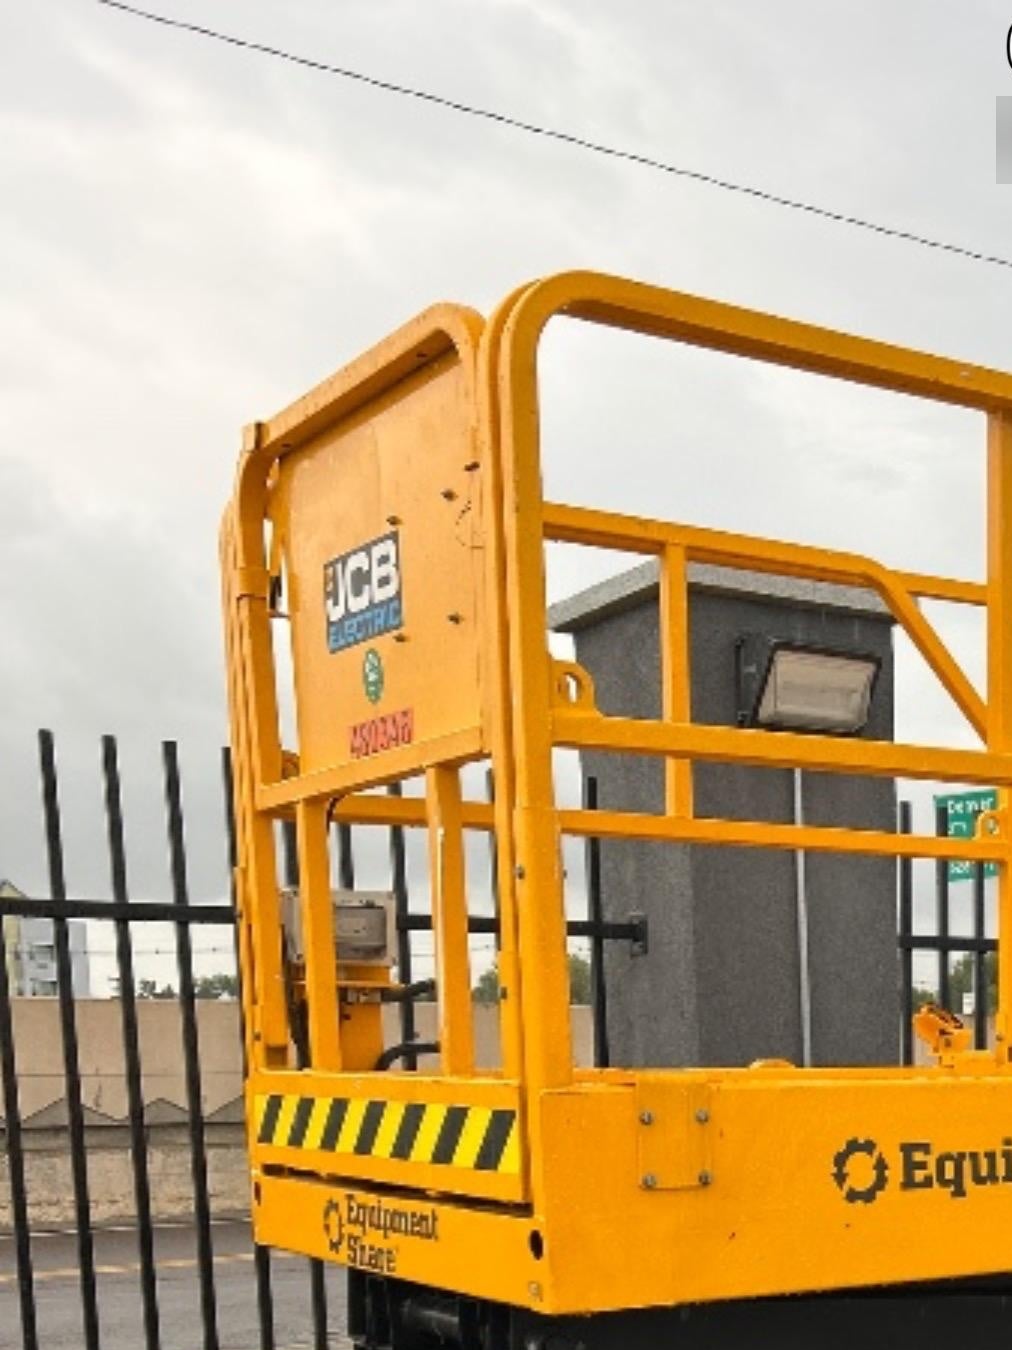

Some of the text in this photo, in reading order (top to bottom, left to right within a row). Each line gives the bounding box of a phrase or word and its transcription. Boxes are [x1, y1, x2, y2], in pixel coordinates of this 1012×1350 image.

[326, 539, 399, 622] JCB
[329, 602, 401, 650] ELECTRIC
[346, 1194, 439, 1240] Equipment
[347, 1234, 397, 1272] Share
